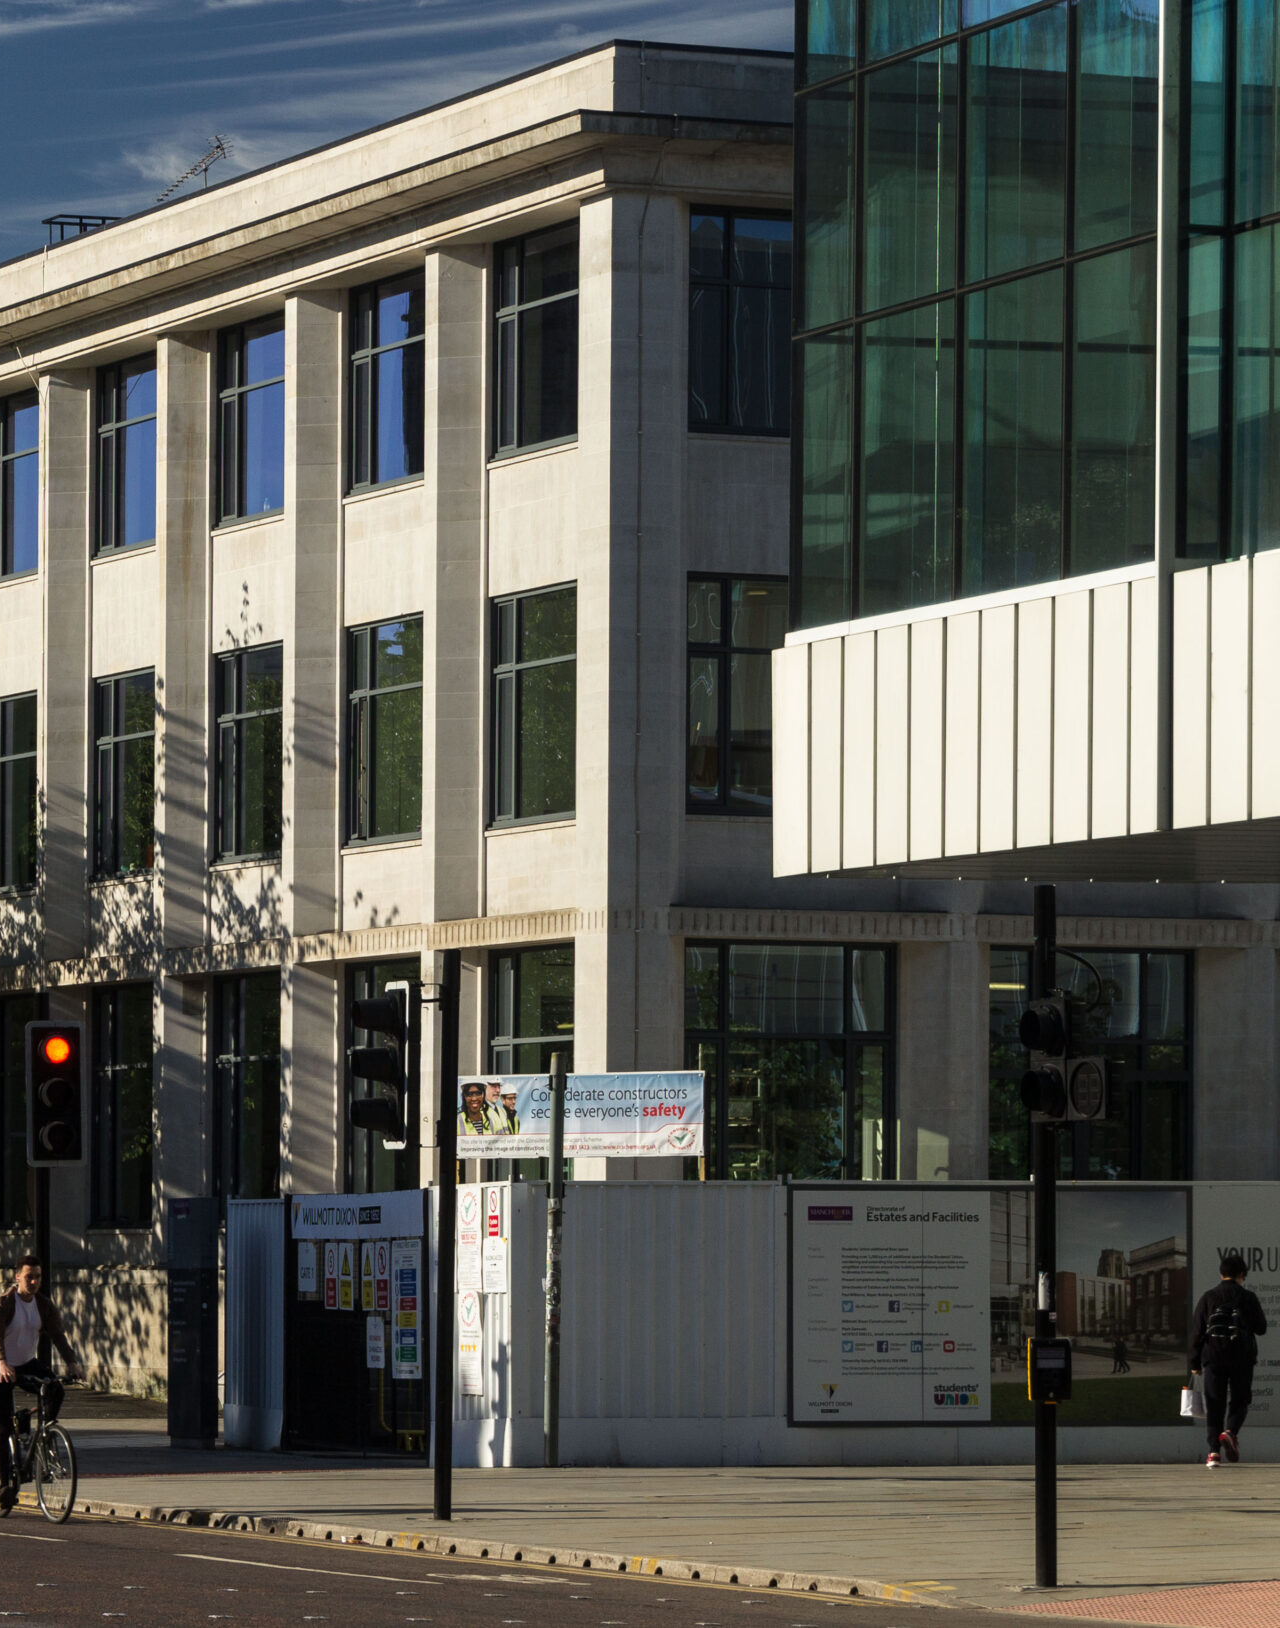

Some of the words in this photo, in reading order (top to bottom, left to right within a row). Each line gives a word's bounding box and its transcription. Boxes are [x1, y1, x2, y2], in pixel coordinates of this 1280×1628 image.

[530, 1087, 604, 1102] Coderate
[608, 1086, 687, 1101] constructors
[530, 1107, 571, 1119] sece
[574, 1102, 639, 1121] everyone's
[642, 1102, 686, 1120] safety
[302, 1207, 335, 1226] WILLMOTT
[335, 1207, 358, 1226] DIXON
[866, 1211, 907, 1222] Estates
[909, 1211, 930, 1222] and
[932, 1211, 979, 1222] Facilities
[933, 1384, 979, 1392] students'
